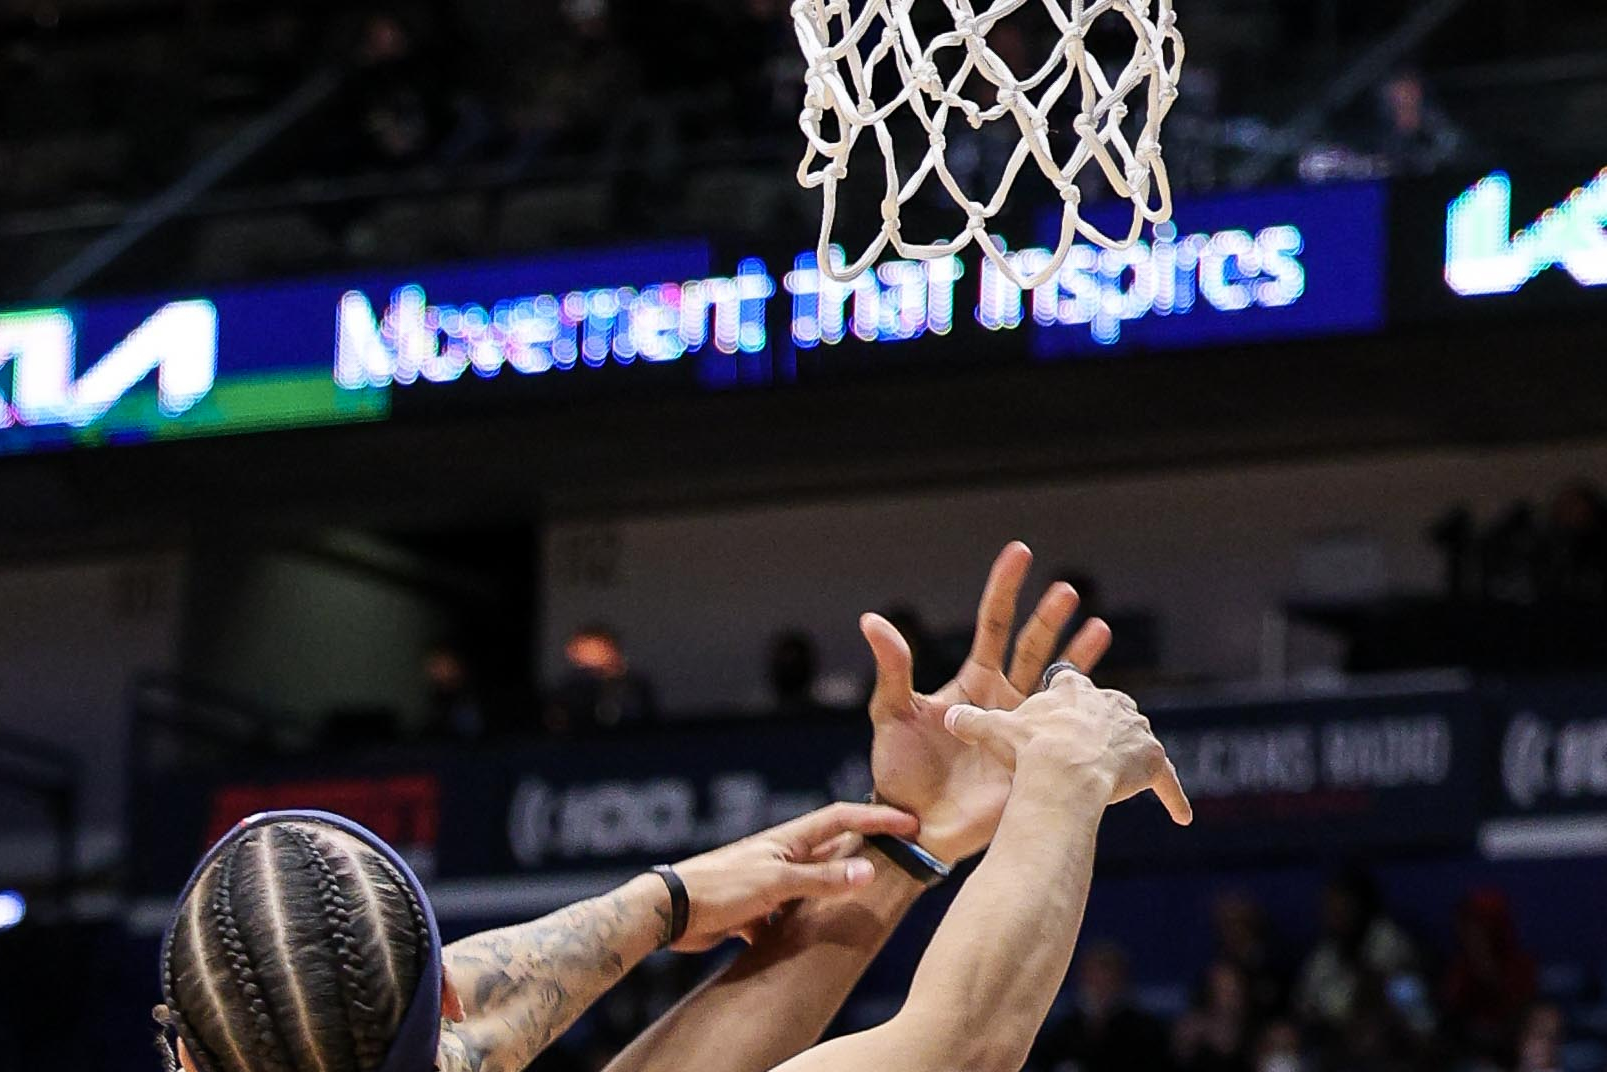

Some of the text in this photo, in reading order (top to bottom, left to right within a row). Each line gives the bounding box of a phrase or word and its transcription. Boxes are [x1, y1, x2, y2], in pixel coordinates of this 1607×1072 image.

[334, 256, 774, 389] Movement
[782, 243, 964, 348] that
[974, 220, 1306, 345] inspires
